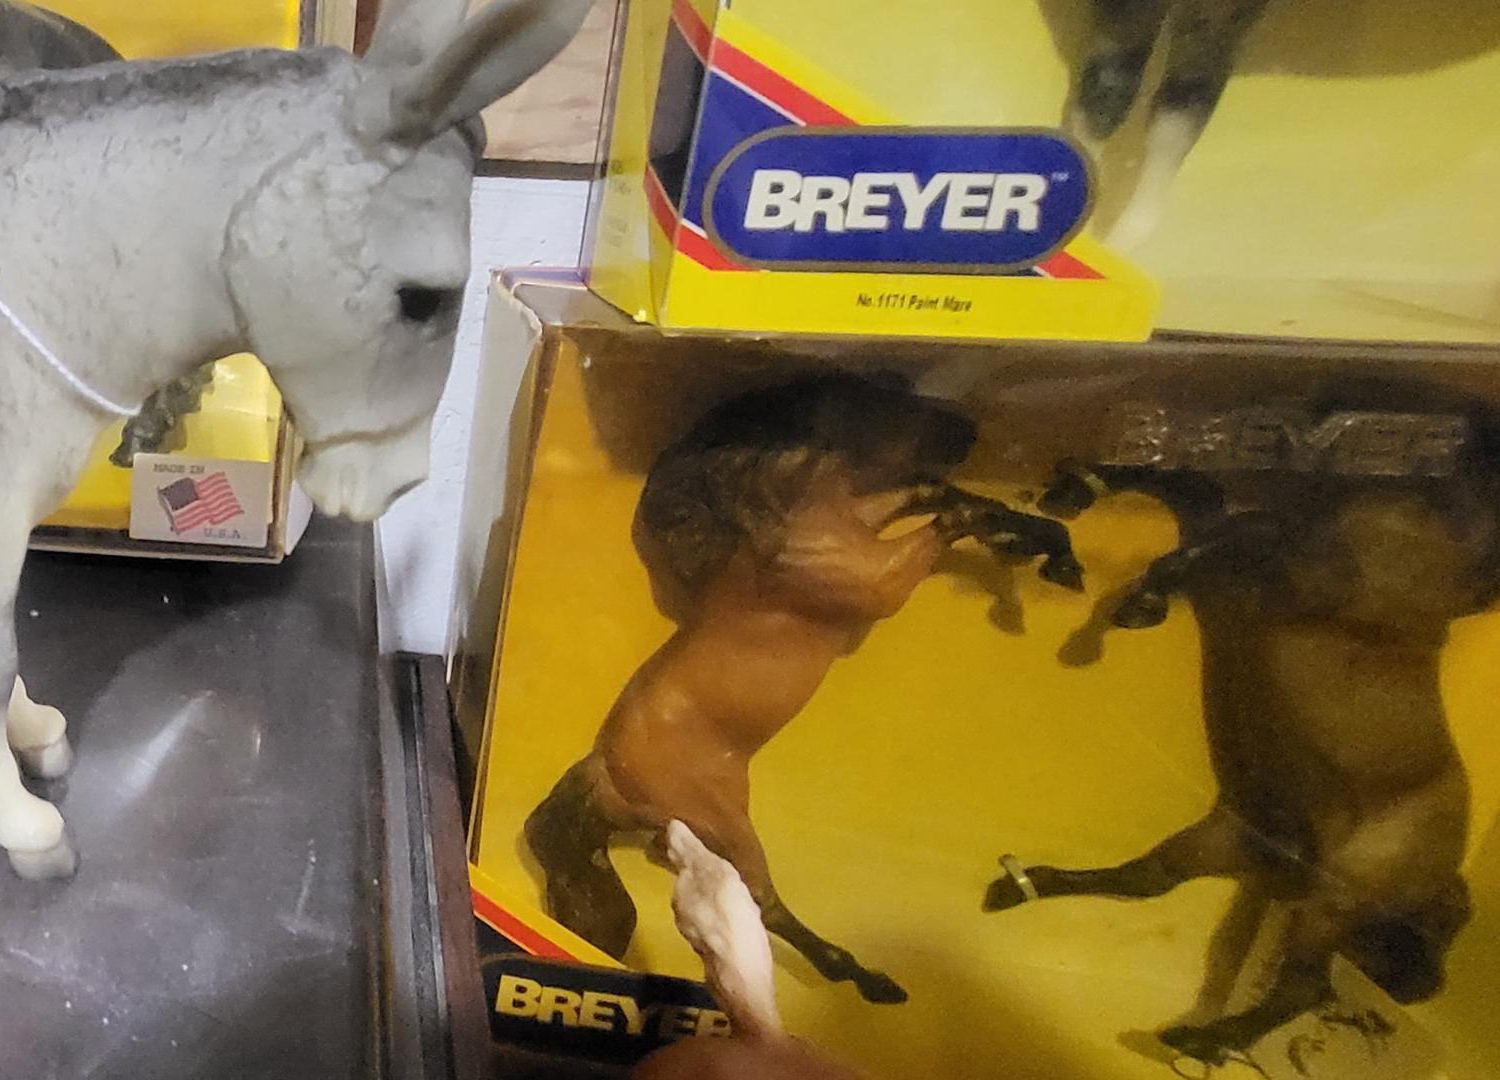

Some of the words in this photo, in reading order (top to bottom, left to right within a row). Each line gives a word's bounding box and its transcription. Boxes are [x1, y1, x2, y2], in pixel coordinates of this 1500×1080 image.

[744, 169, 1049, 233] BREYER
[908, 295, 939, 310] Paint
[153, 463, 185, 473] MADE
[189, 464, 205, 474] IN
